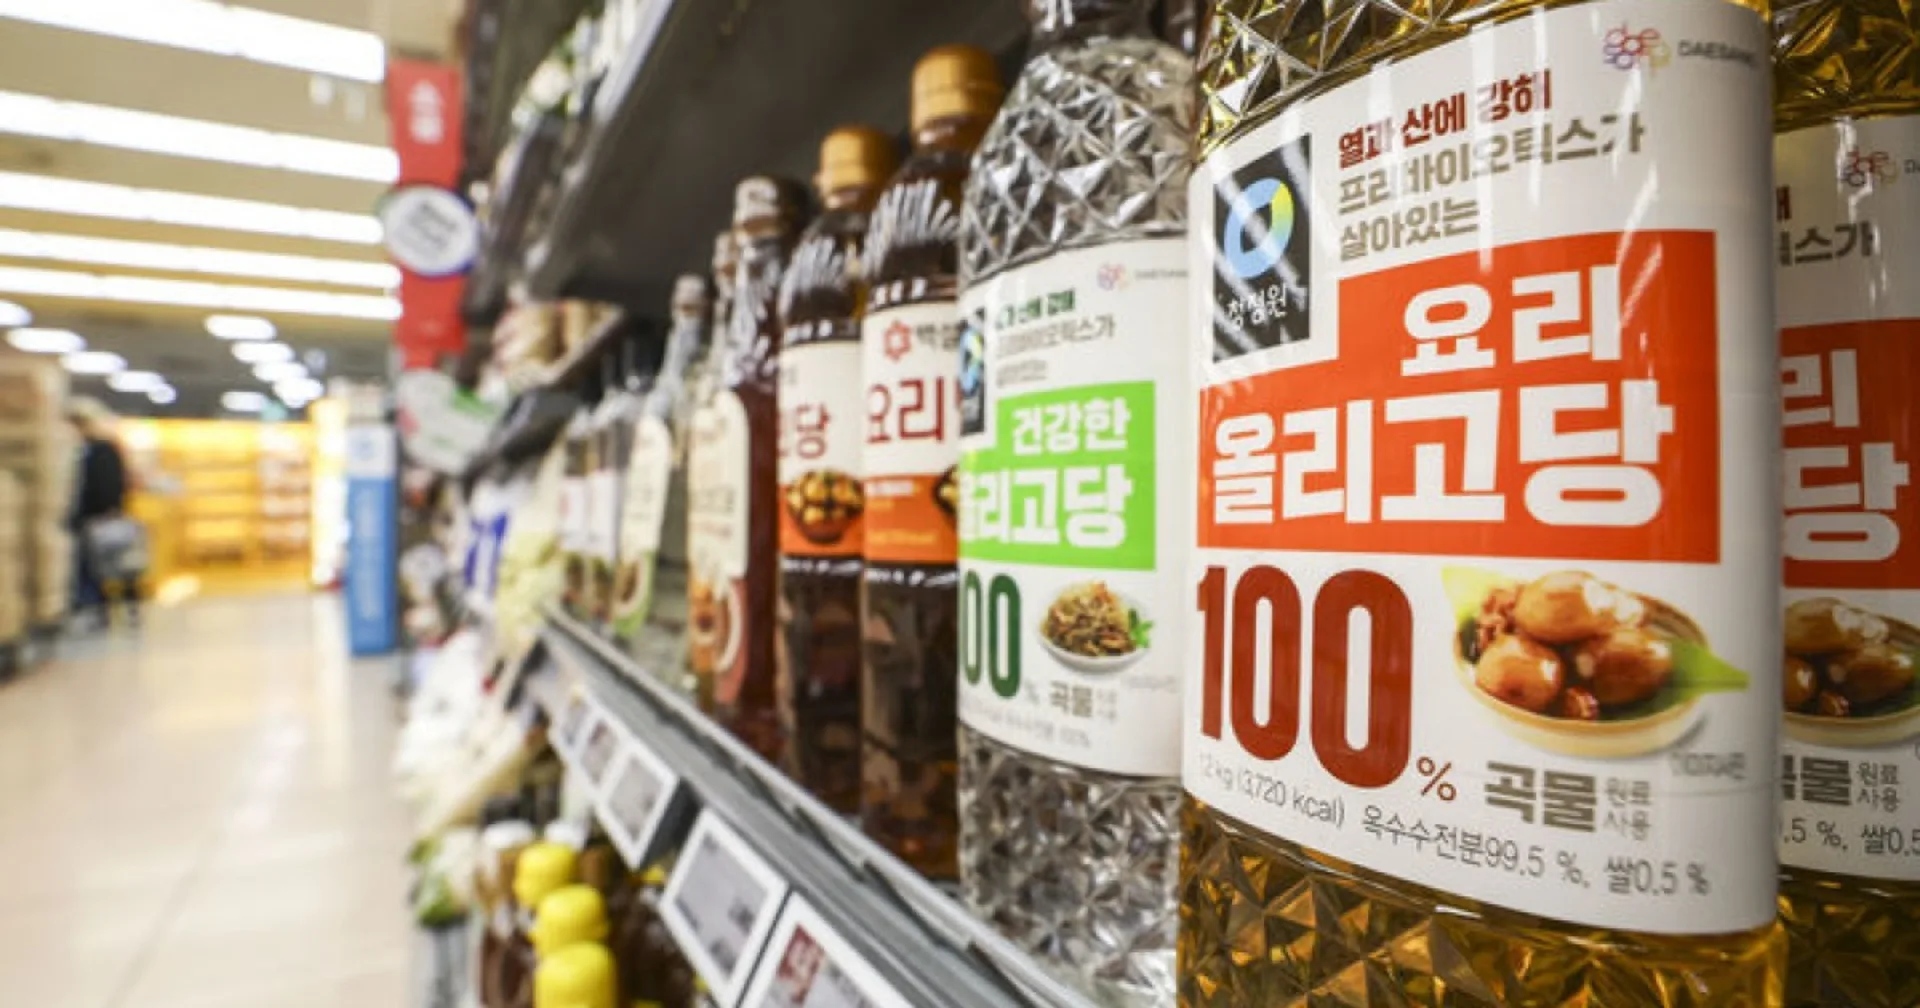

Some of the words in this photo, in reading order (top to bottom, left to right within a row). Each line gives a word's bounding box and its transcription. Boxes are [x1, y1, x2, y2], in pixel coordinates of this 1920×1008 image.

[1401, 91, 1466, 148] 산에
[1477, 67, 1552, 123] 강해
[1338, 112, 1645, 215] 프리바이오틱스가
[1338, 198, 1478, 262] 살아있는
[1780, 221, 1873, 267] 스가
[1402, 263, 1622, 377] 요리
[867, 376, 961, 443] 요리
[1012, 395, 1132, 457] 건강한
[1213, 379, 1674, 526] 올리고당
[1196, 564, 1413, 788] 100
[1416, 756, 1457, 801] %
[1484, 760, 1597, 833] 곡물
[1857, 761, 1899, 787] 원료
[1857, 786, 1900, 813] 사용
[1292, 785, 1346, 830] kcal)
[1363, 802, 1547, 879] 옥수수전분99.5
[1604, 855, 1679, 895] 쌀0.5
[1687, 861, 1710, 896] %
